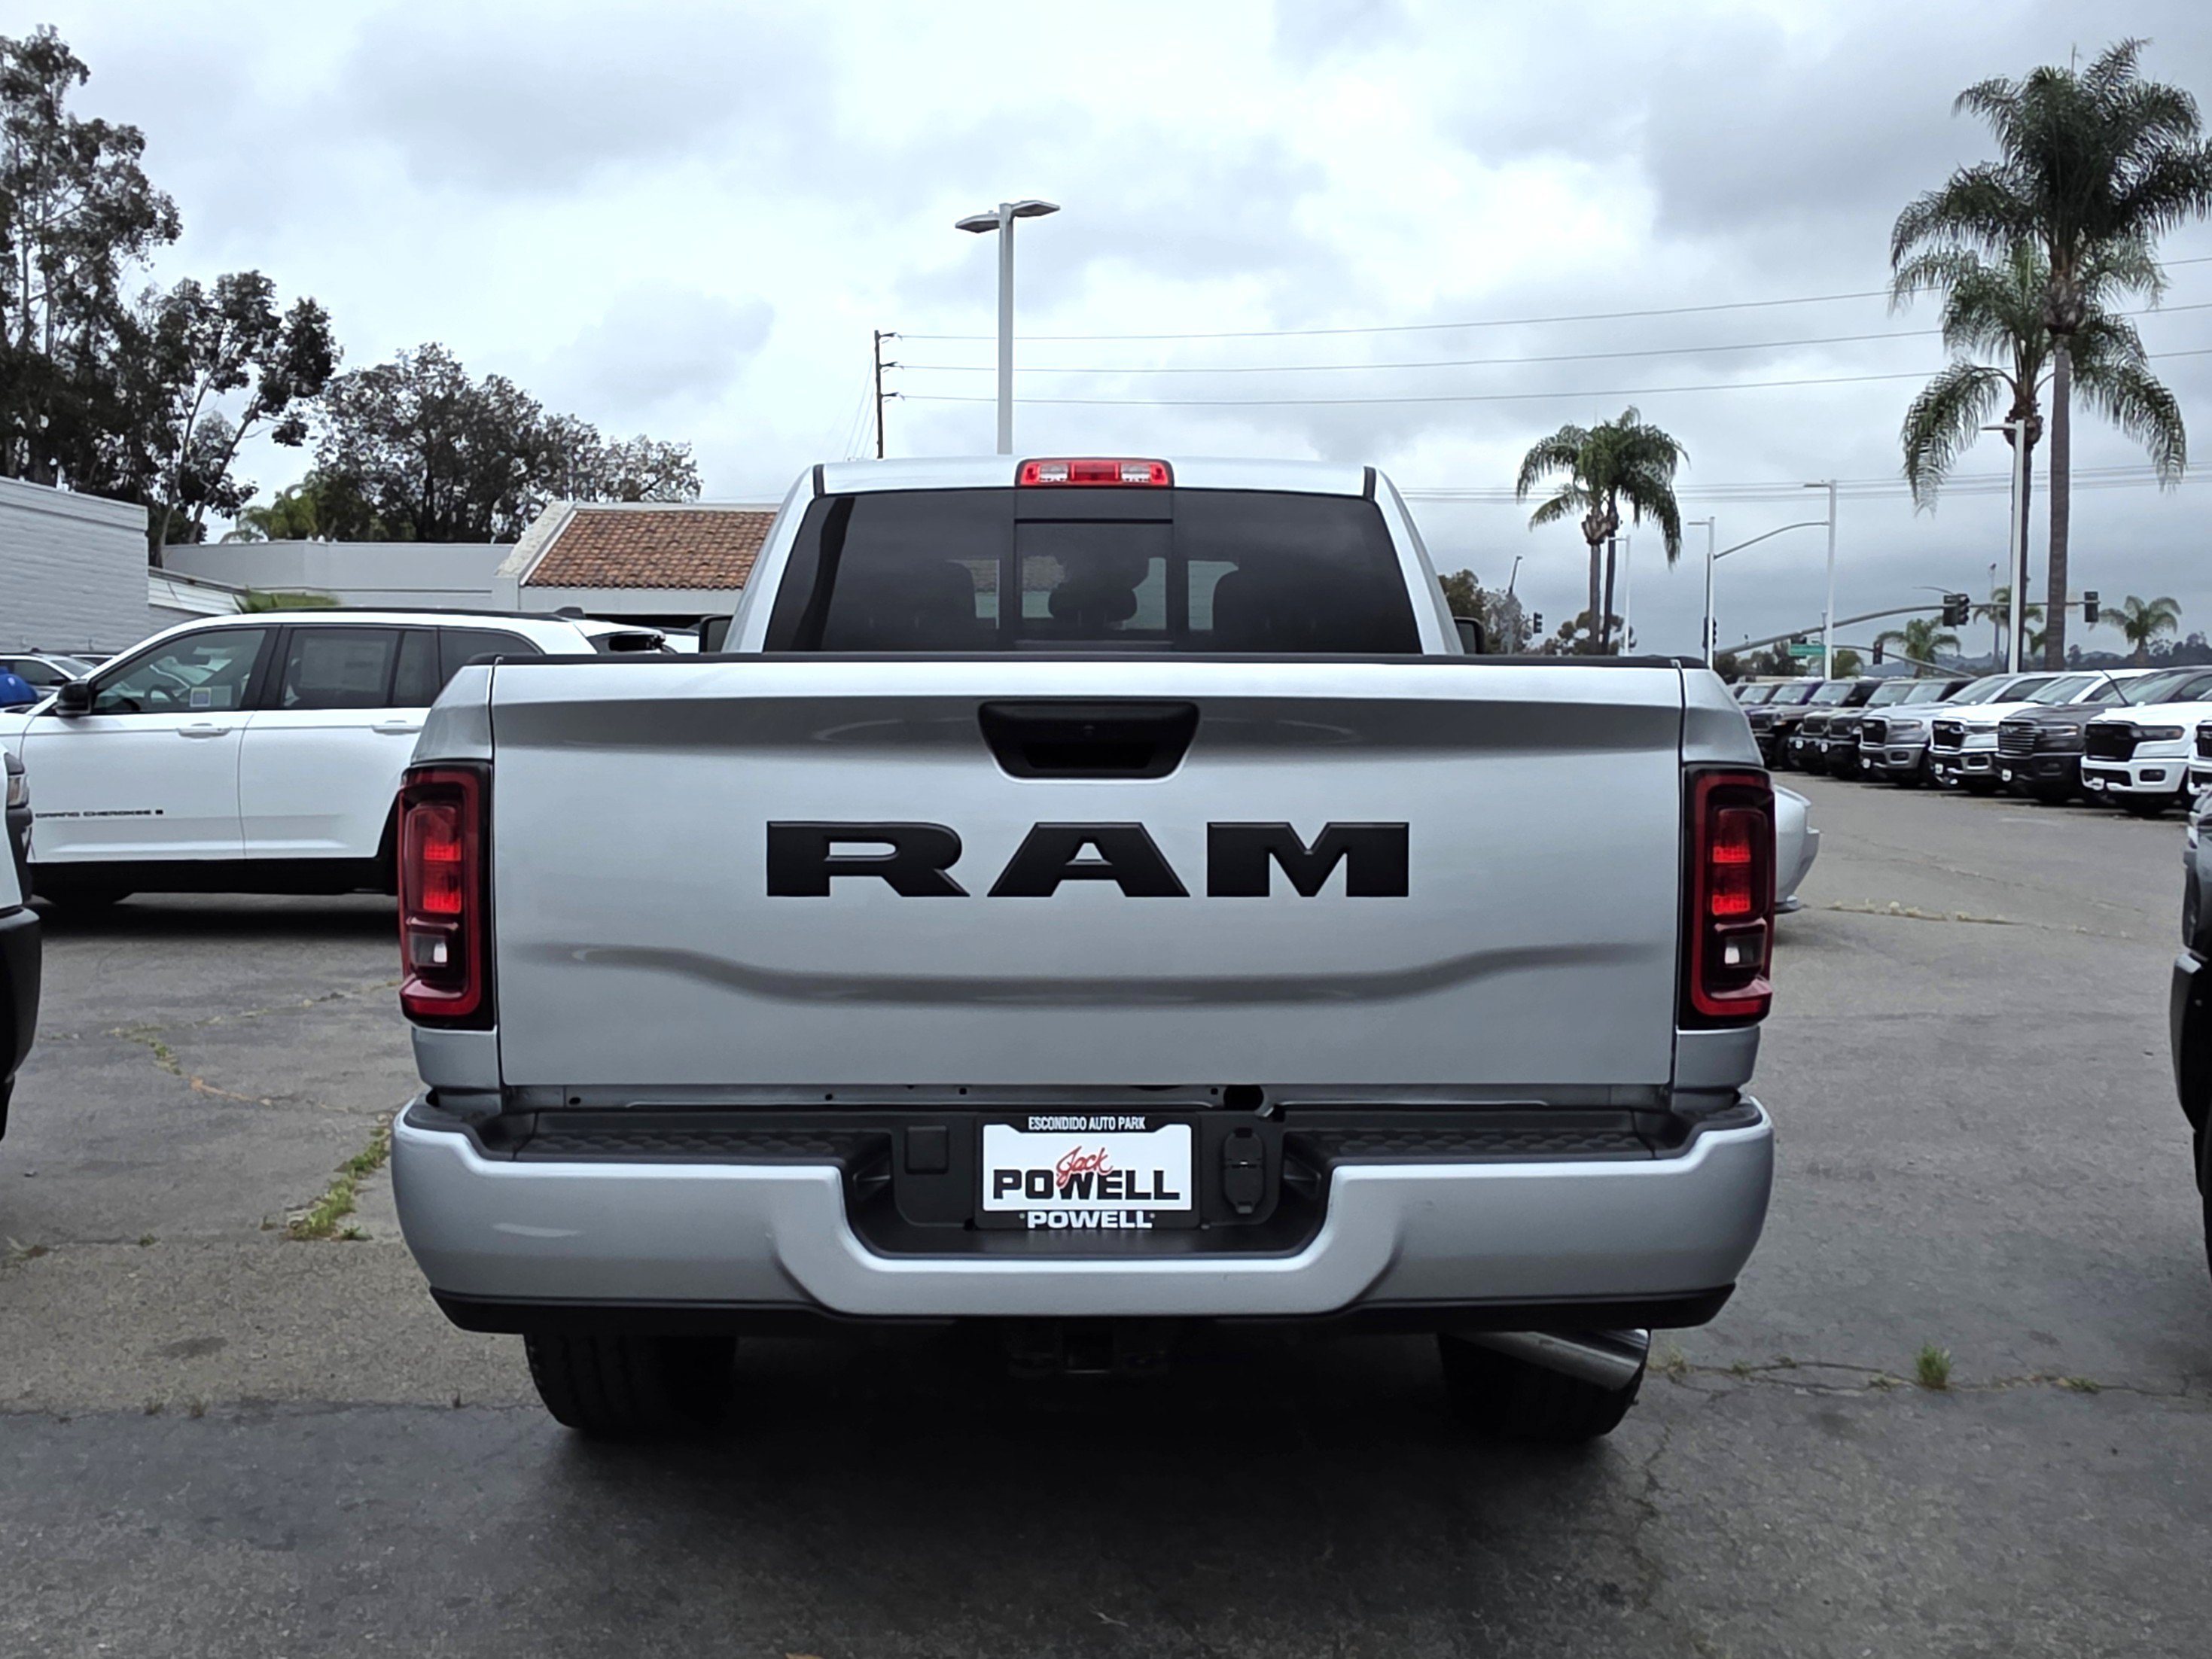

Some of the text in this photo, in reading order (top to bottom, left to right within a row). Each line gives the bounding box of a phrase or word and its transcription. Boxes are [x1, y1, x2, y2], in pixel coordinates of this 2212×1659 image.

[766, 820, 1410, 897] RAM
[1028, 1116, 1146, 1130] ESCONDIDO AUTO PARK
[1056, 1146, 1114, 1188] Jack
[993, 1169, 1181, 1200] POWELL
[1027, 1210, 1153, 1228] POWELL
